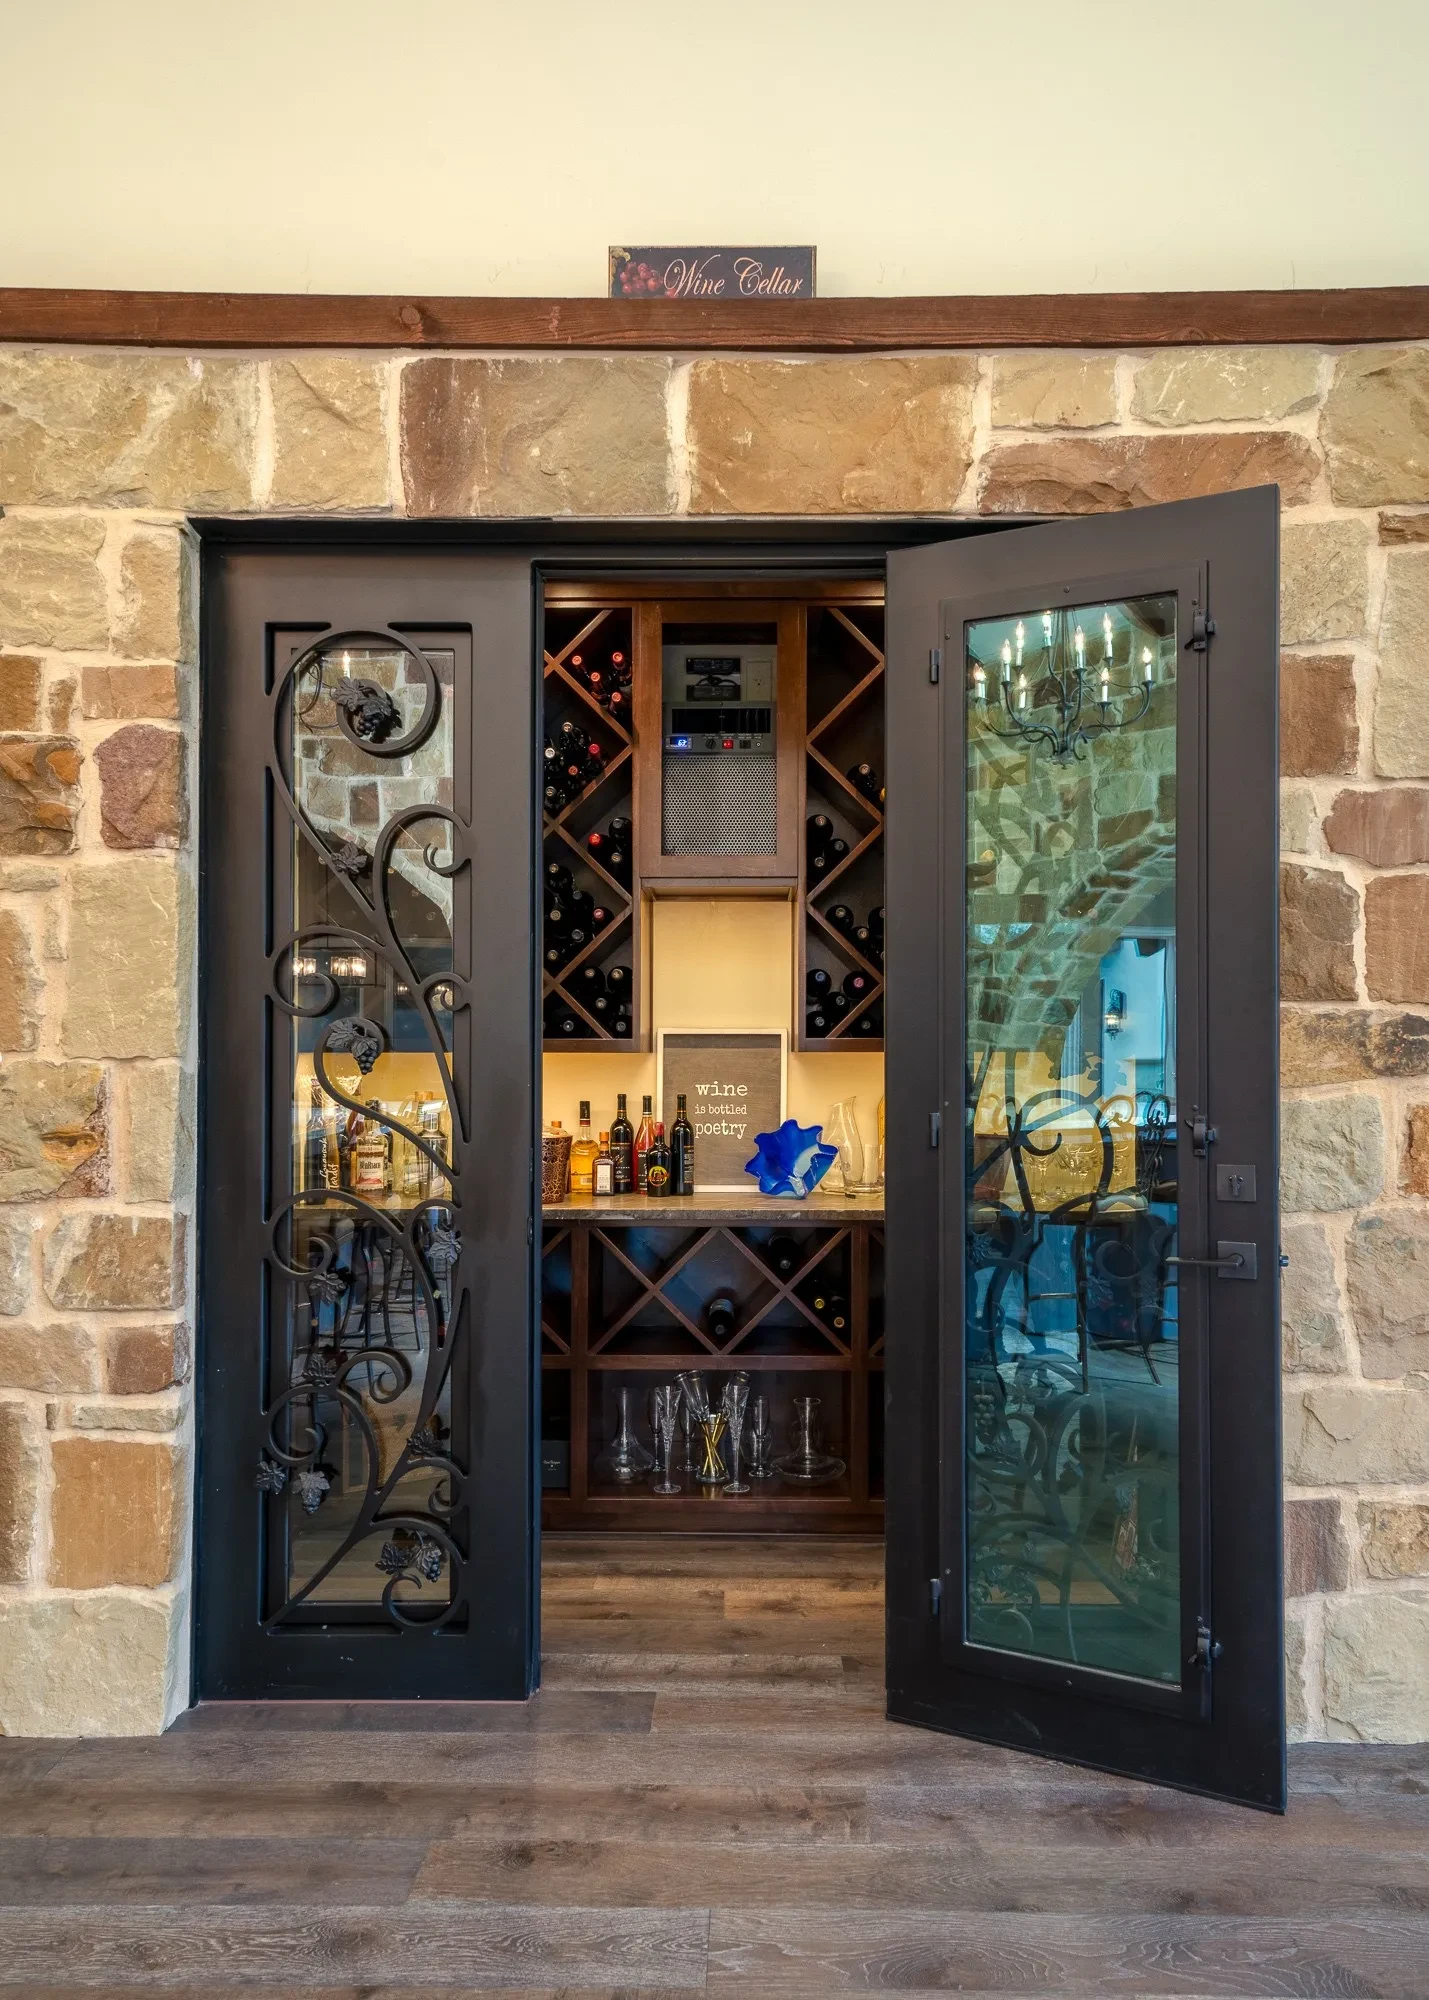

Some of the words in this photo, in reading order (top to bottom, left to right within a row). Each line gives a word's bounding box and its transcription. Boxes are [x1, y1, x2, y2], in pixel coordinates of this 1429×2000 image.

[664, 254, 726, 297] Wine
[733, 256, 803, 296] Cellar
[695, 1080, 748, 1097] wine
[695, 1103, 706, 1115] is
[707, 1103, 748, 1115] bottled
[694, 1119, 748, 1140] poetry
